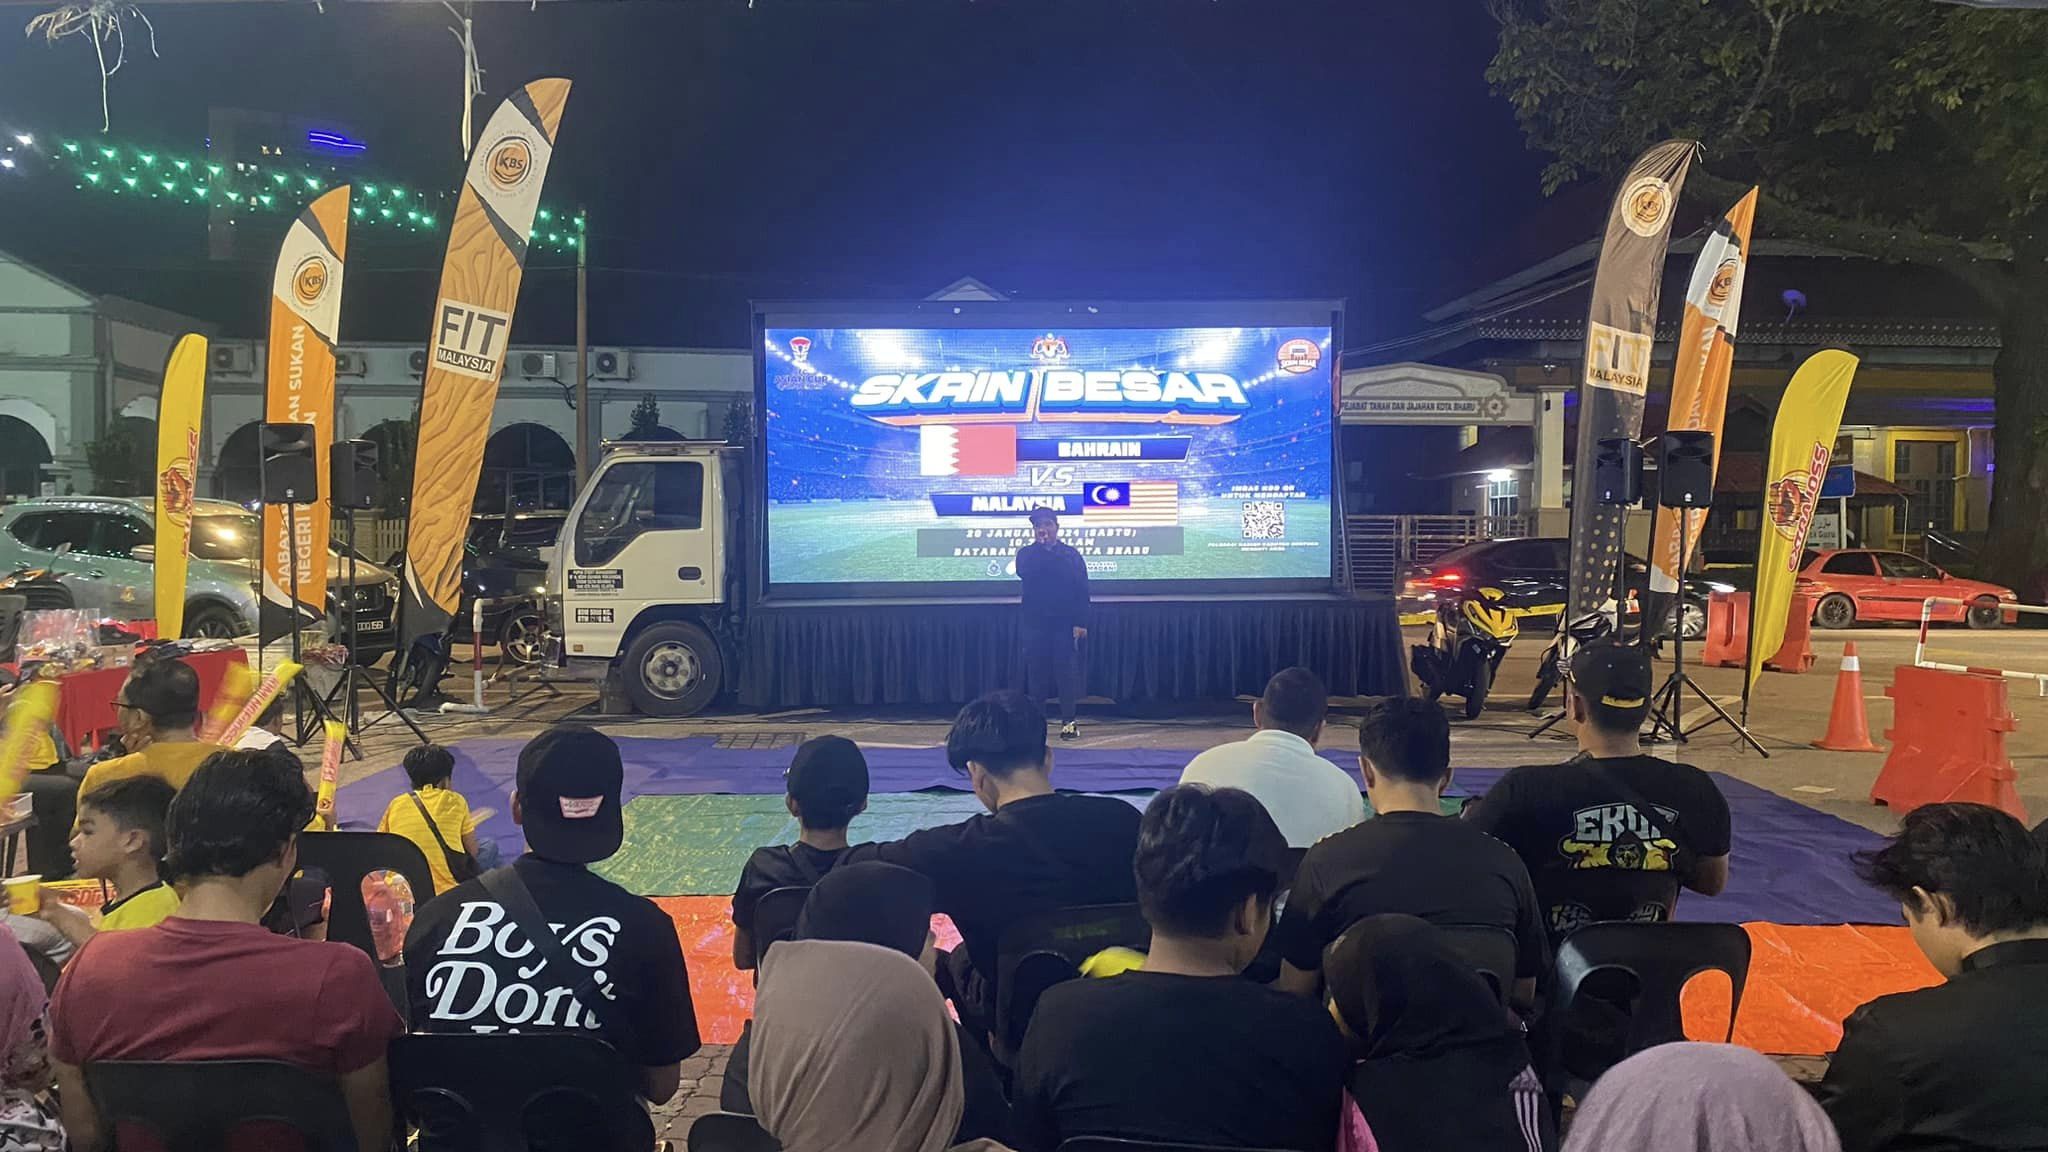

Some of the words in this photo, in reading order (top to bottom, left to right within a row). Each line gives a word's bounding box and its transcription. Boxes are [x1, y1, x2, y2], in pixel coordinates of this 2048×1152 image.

[499, 156, 523, 170] KBS
[438, 304, 506, 355] FIT
[289, 325, 305, 390] SUKAN
[437, 348, 493, 372] MALAYSIA
[1591, 330, 1650, 371] FIT
[1044, 370, 1248, 403] BESAR
[288, 395, 300, 422] AN
[1058, 442, 1141, 457] BAHRAIN
[1030, 466, 1075, 486] VS
[971, 496, 1066, 512] MALAYSIA
[966, 529, 982, 537] 20
[986, 529, 1035, 537] JANUA
[296, 517, 311, 584] NEGERI
